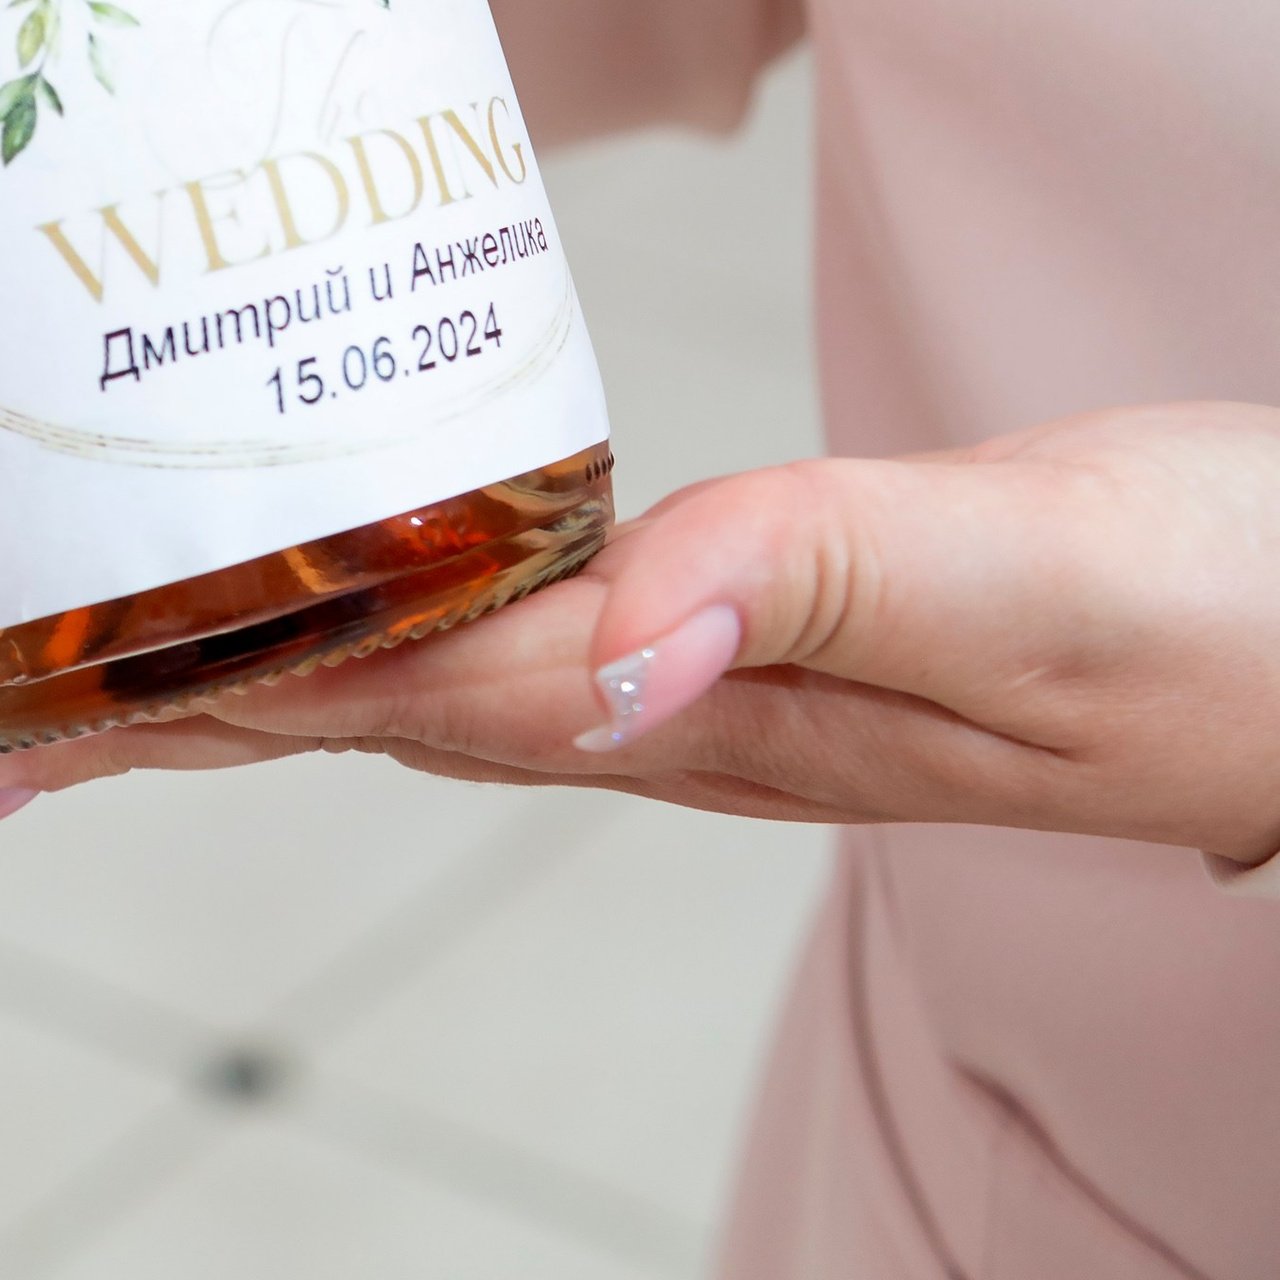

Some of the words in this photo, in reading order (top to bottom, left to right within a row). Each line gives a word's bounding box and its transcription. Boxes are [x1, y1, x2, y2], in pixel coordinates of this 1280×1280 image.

[35, 96, 527, 302] WEDDING
[99, 265, 352, 390] Дмитрий
[369, 262, 393, 301] и
[411, 216, 549, 293] Анжелика
[266, 302, 503, 414] 15.06.2024
